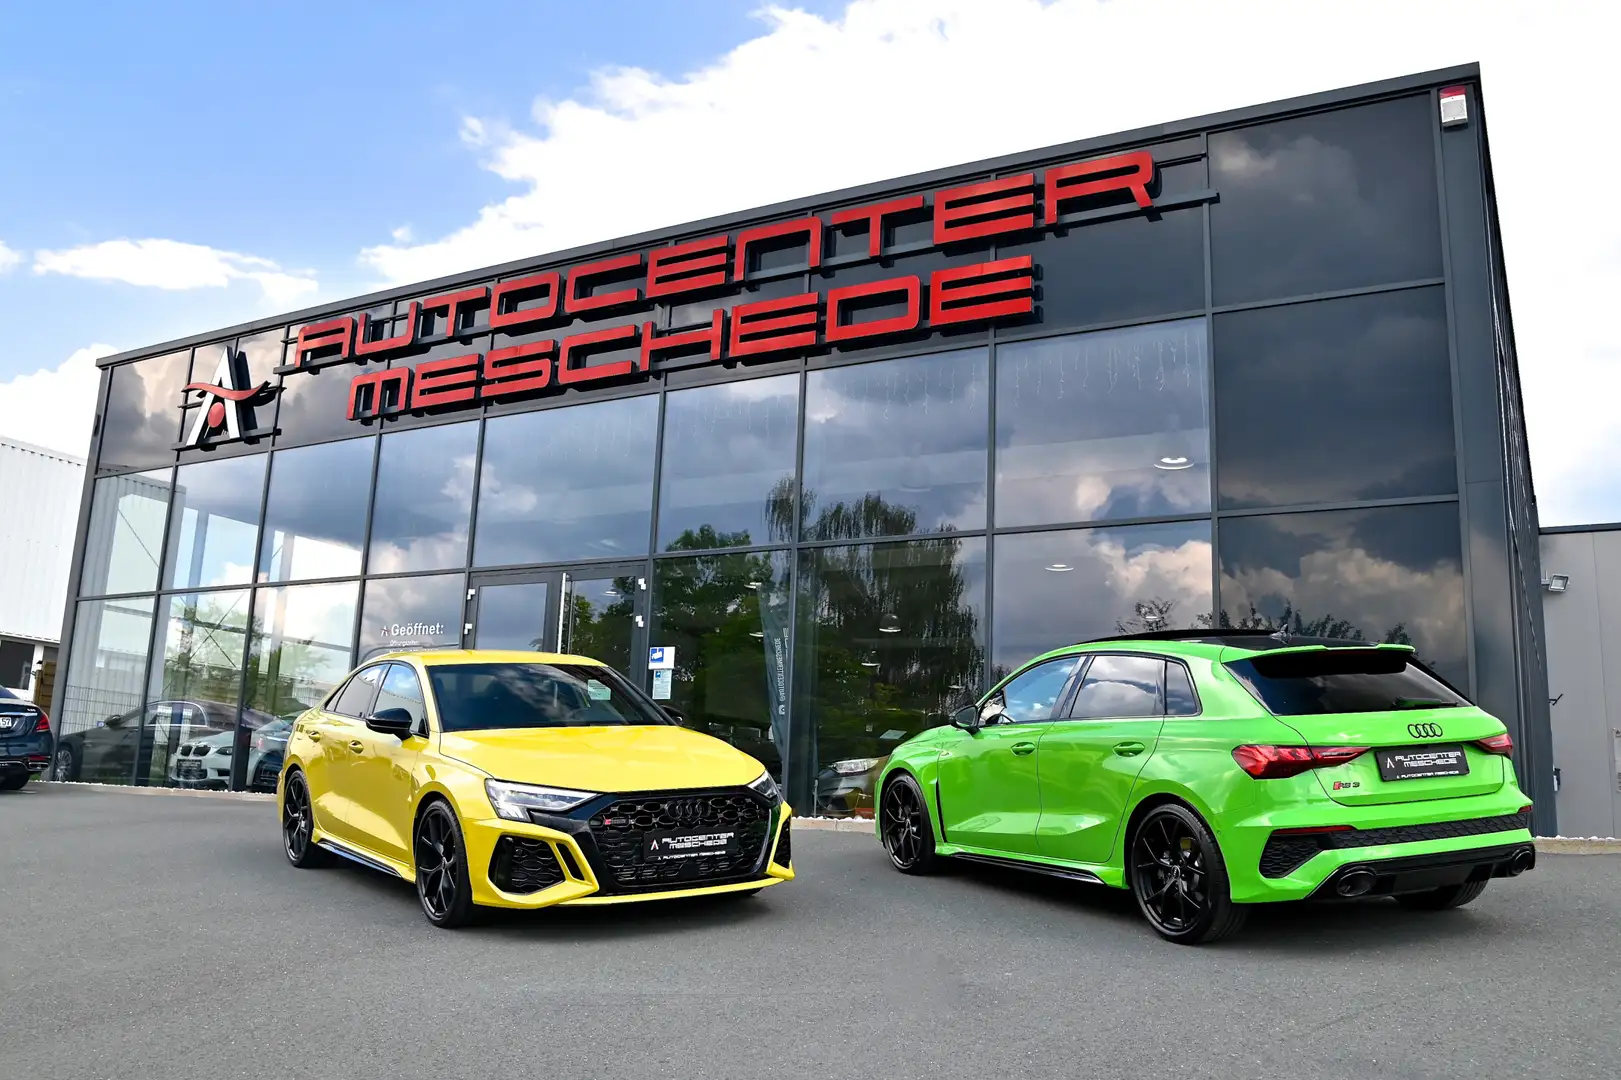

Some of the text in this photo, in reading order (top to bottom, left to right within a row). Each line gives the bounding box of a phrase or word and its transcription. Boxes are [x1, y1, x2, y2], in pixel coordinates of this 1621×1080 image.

[294, 150, 1156, 370] AUTOCENTER
[346, 254, 1036, 422] MESCHEDE
[391, 622, 444, 636] Geöffnet:
